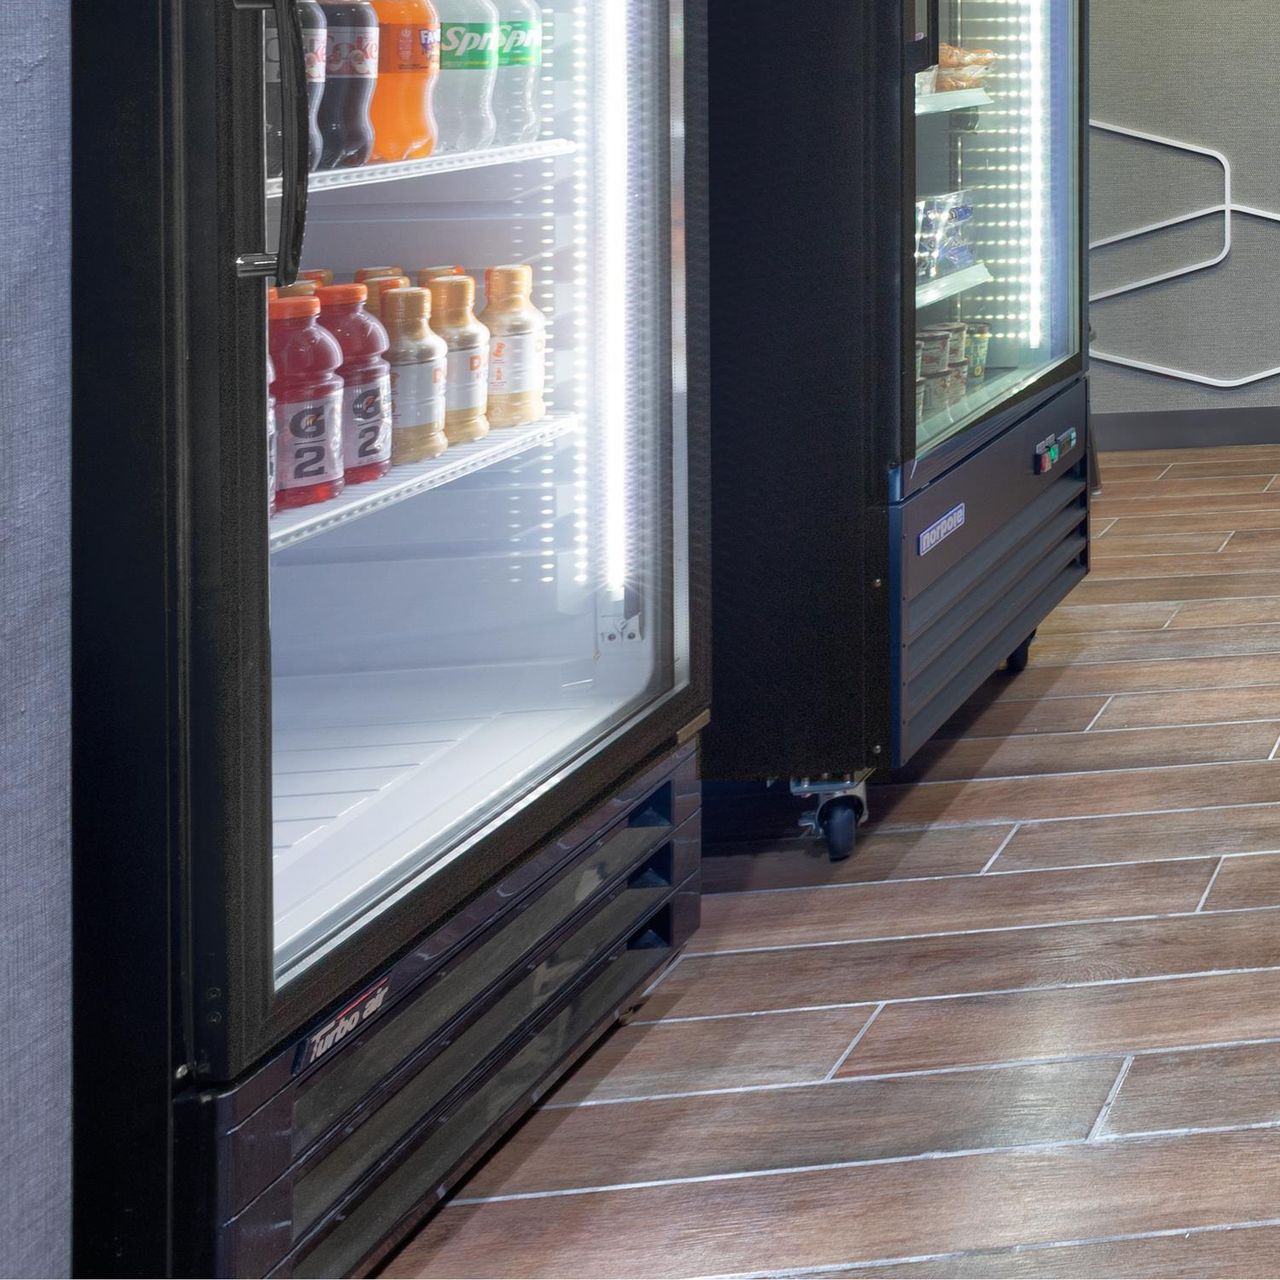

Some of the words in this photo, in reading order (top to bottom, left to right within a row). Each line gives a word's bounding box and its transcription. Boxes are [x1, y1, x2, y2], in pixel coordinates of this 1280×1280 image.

[922, 508, 964, 551] norpole
[309, 1010, 360, 1064] Turbo
[362, 986, 389, 1019] air
